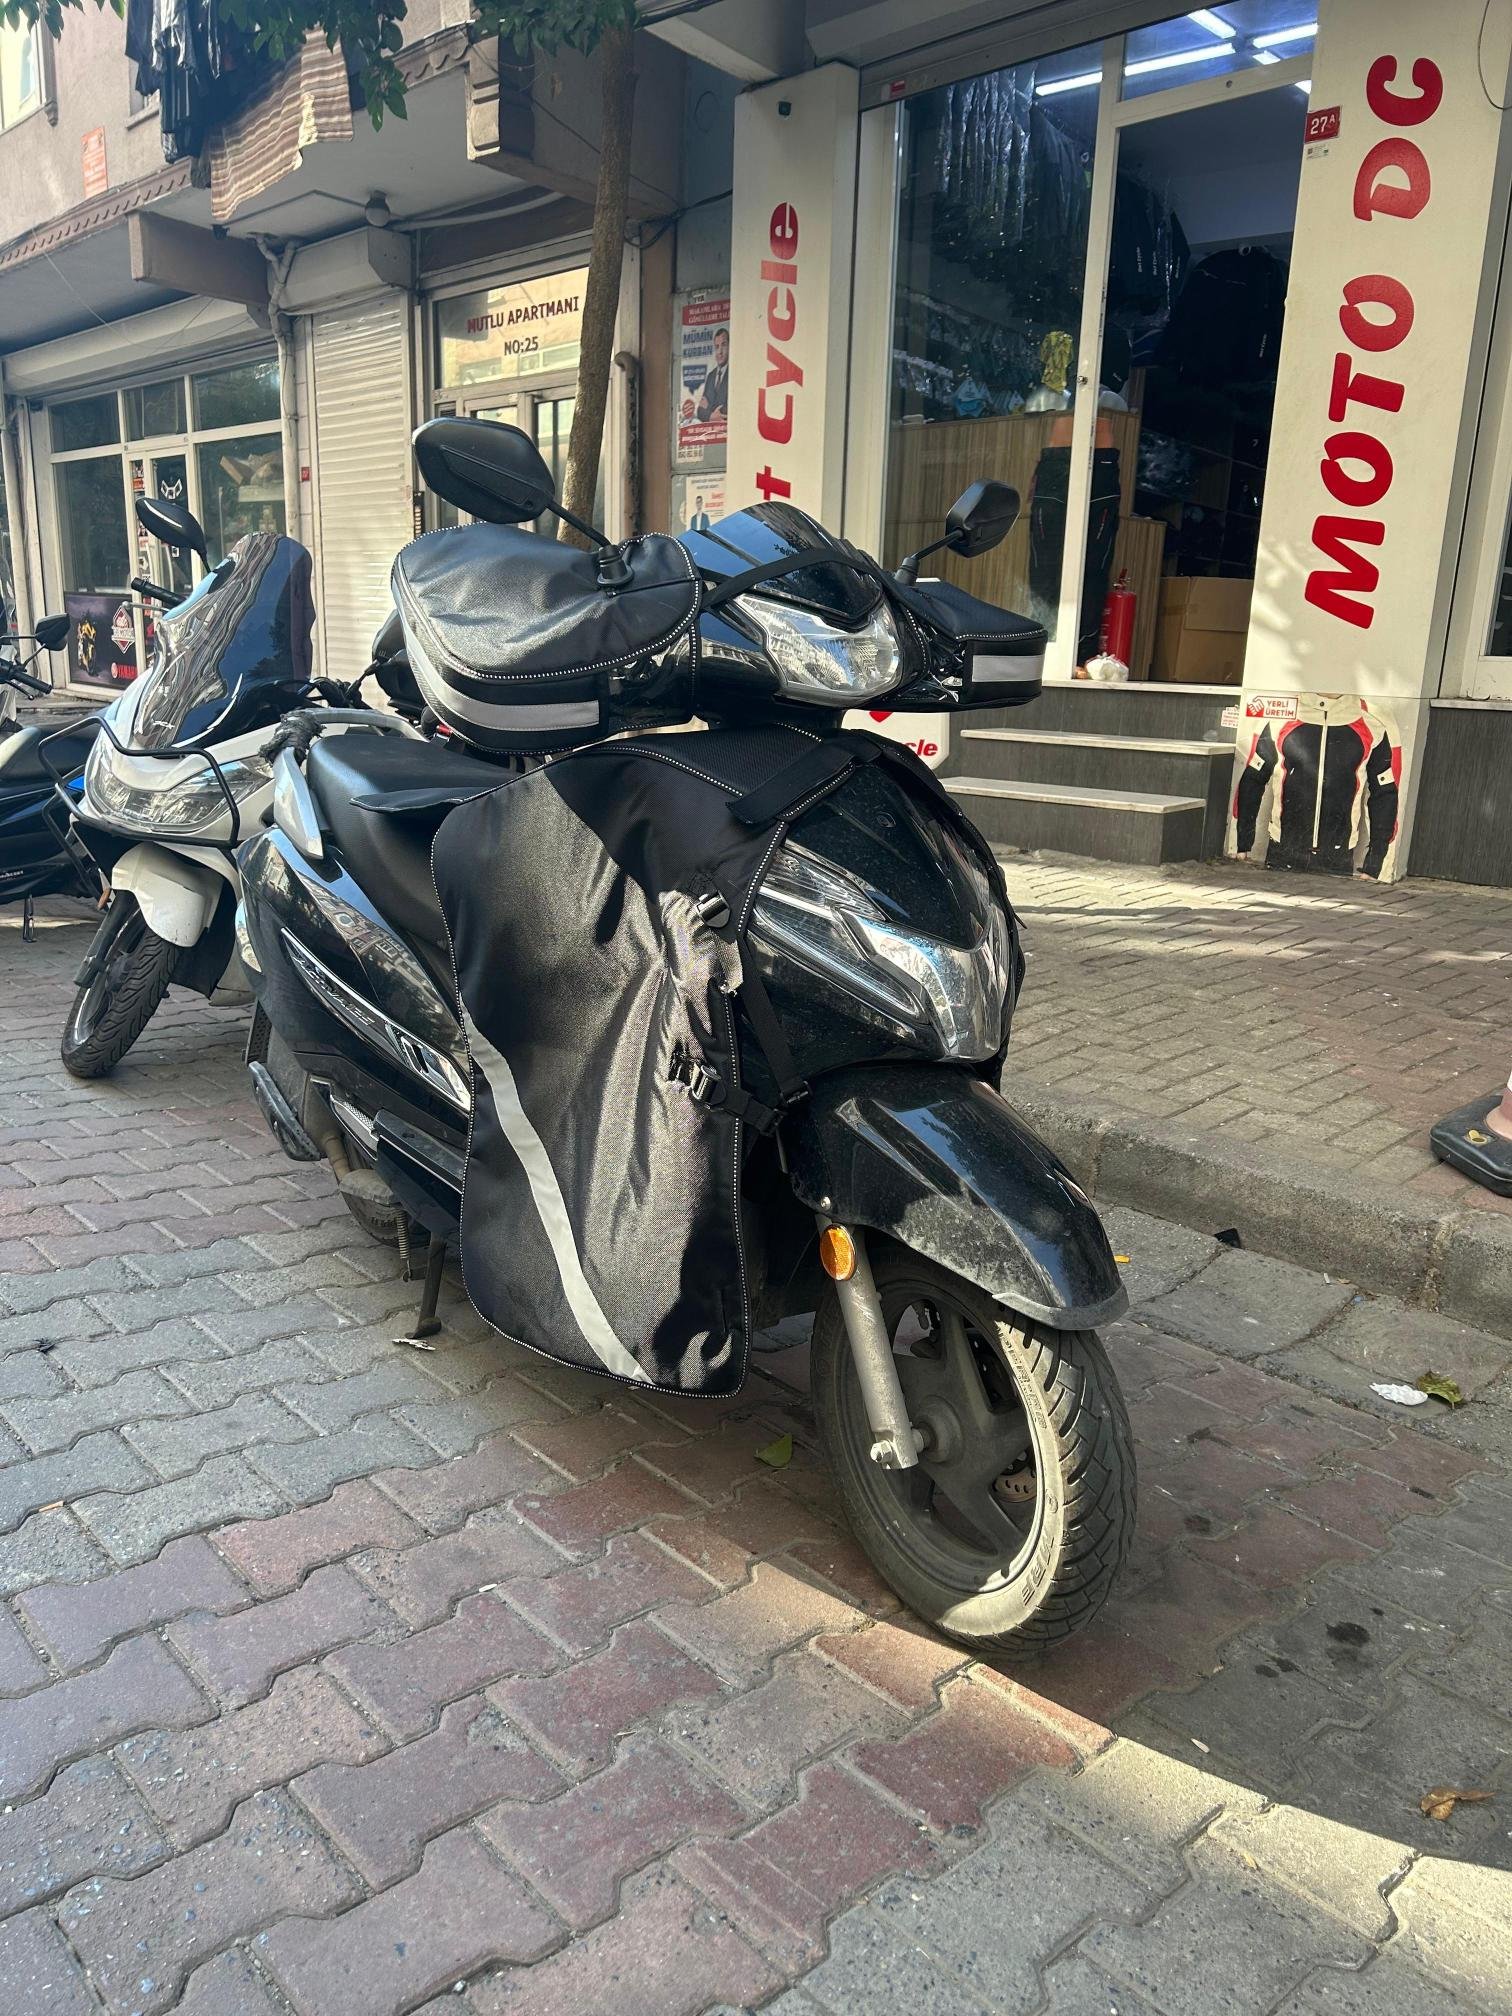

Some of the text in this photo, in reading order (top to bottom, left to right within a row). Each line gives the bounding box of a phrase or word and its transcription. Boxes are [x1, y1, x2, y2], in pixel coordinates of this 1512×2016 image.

[467, 296, 579, 334] MUTLU APARTMANI
[757, 201, 804, 445] Cycle
[504, 336, 539, 356] NO:25
[1304, 54, 1443, 630] MOTO DC
[1265, 708, 1295, 718] ÜRETİM
[1266, 700, 1289, 708] YERLİ
